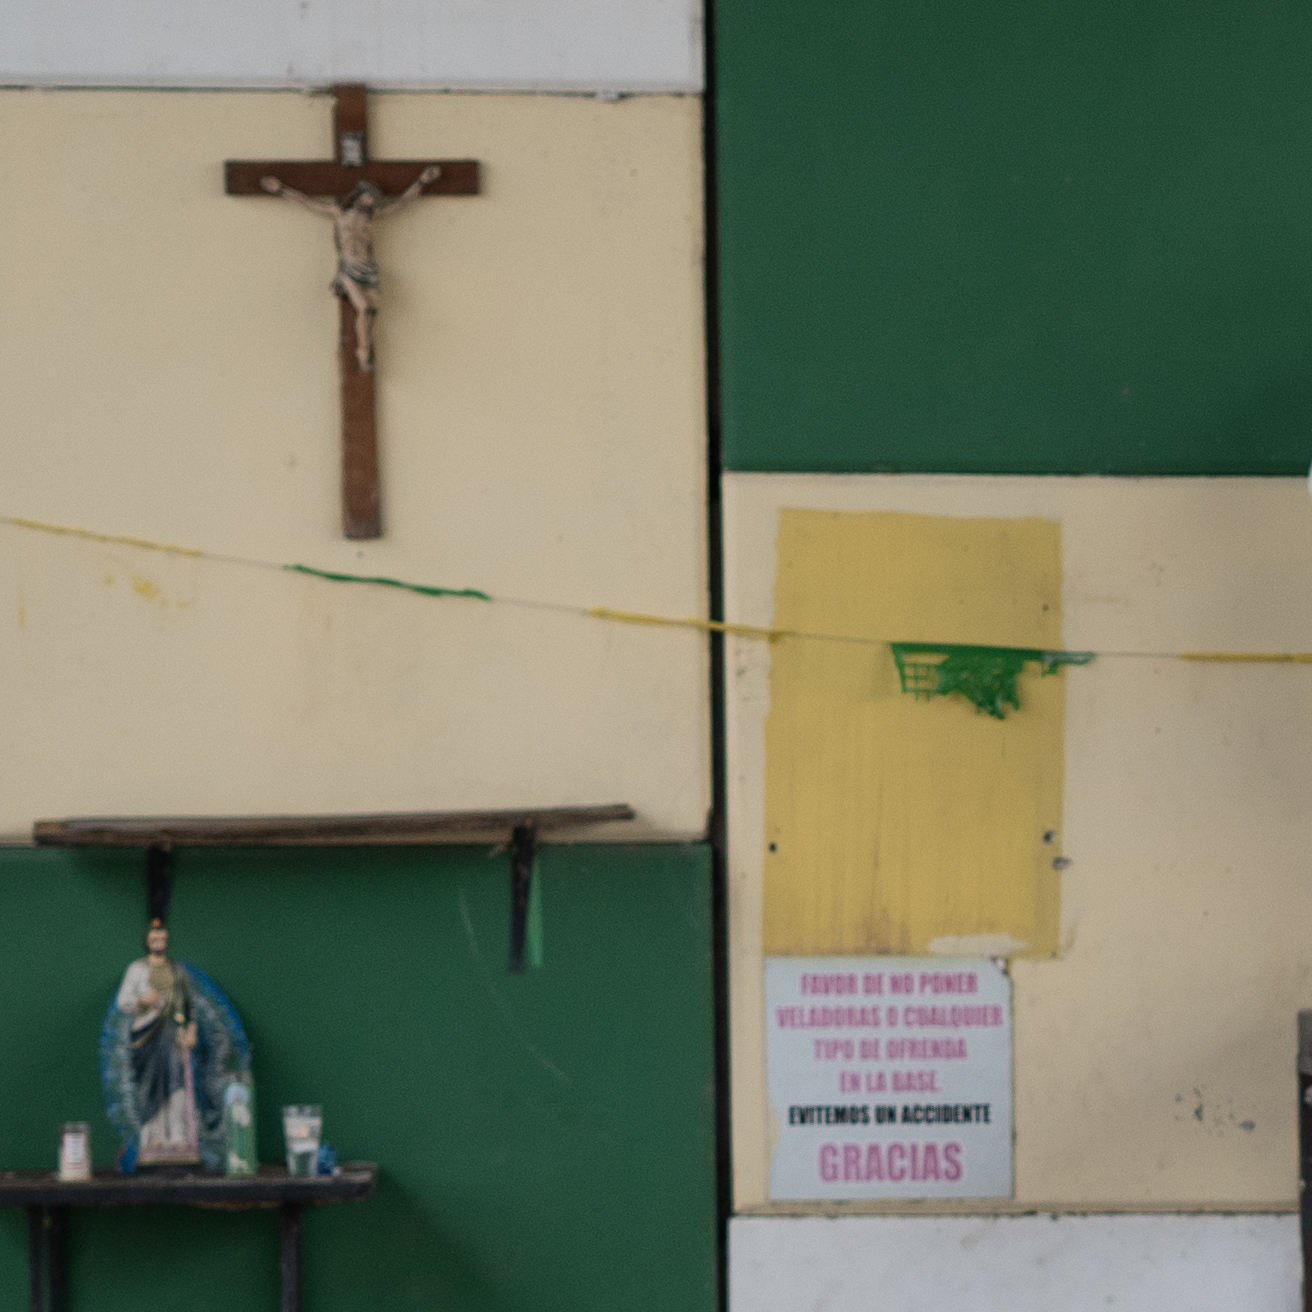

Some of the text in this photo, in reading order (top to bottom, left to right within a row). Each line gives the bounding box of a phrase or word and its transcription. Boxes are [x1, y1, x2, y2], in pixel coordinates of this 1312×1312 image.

[800, 972, 979, 995] FAVOR DE NO PONER
[814, 1037, 968, 1061] TIPO DE OFRENDA
[838, 1070, 861, 1093] EN
[865, 1070, 887, 1093] LA
[788, 1103, 992, 1125] EVITEMOS UN ACCIDENTE
[818, 1141, 964, 1183] GRACIAS
